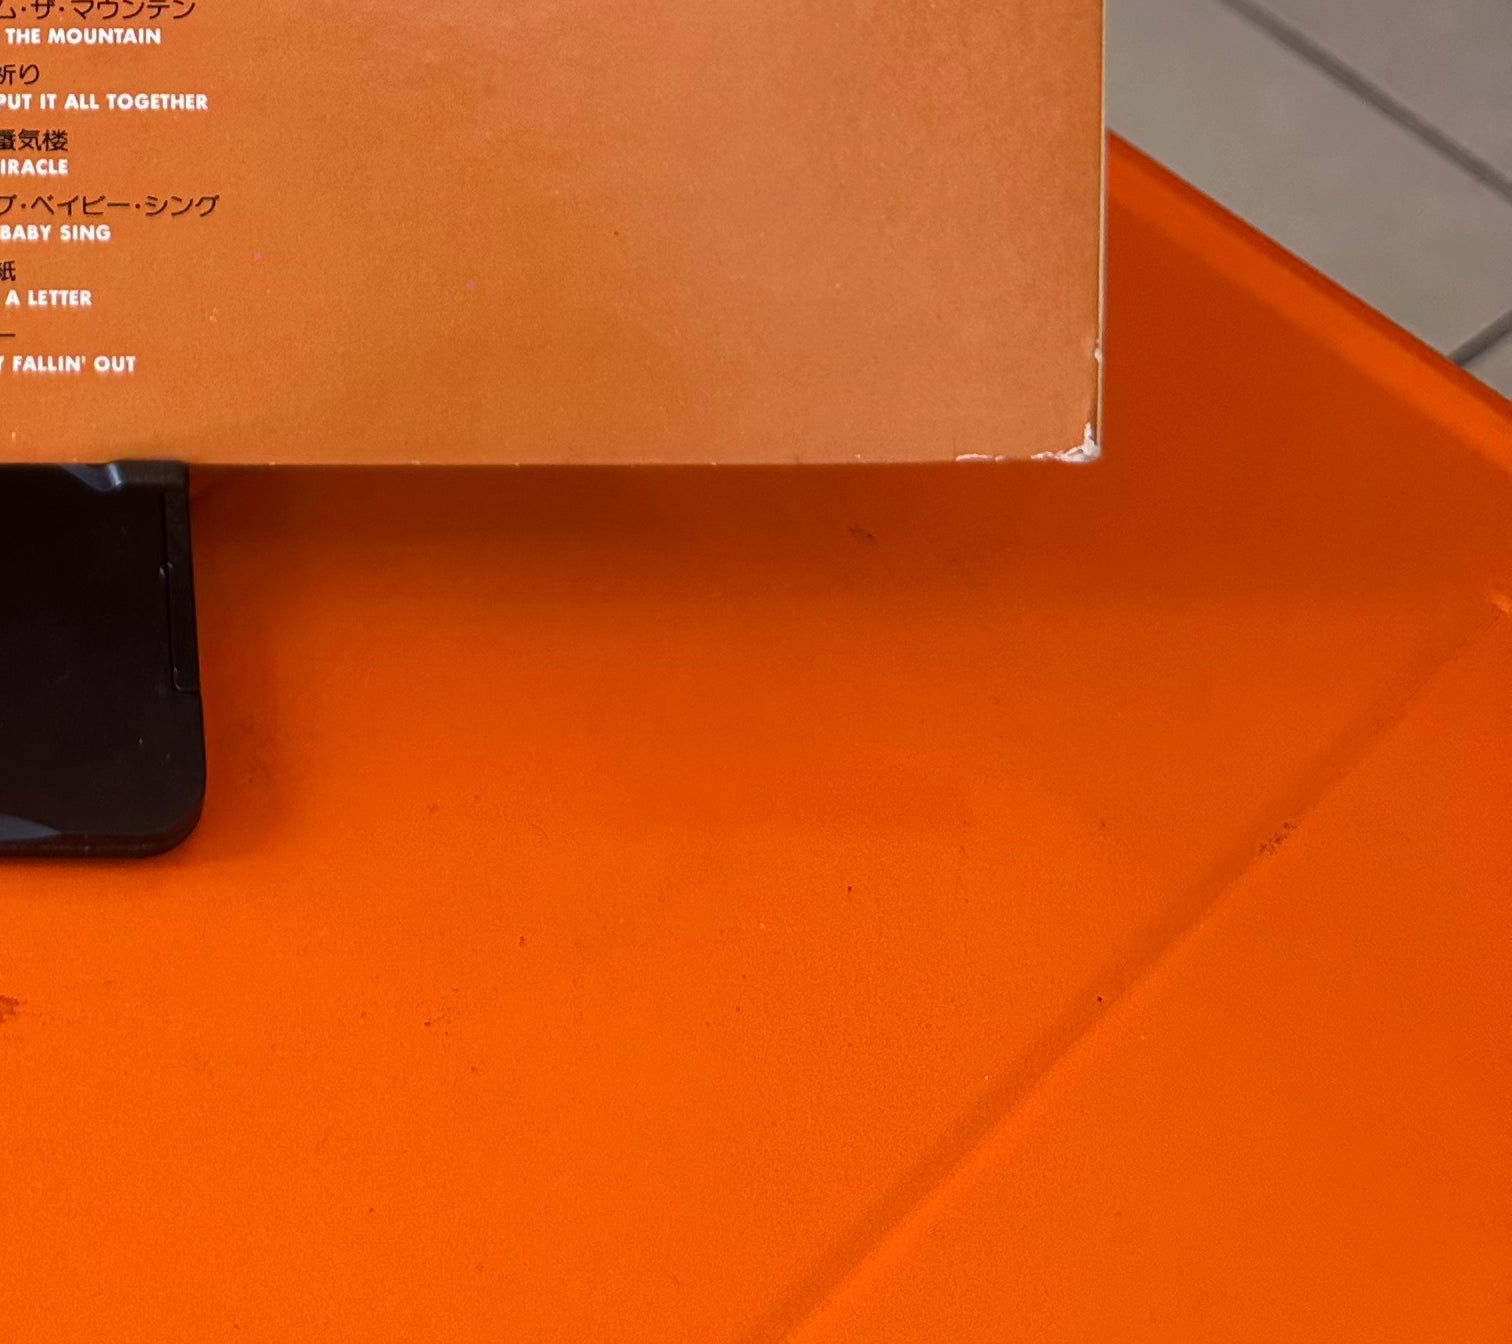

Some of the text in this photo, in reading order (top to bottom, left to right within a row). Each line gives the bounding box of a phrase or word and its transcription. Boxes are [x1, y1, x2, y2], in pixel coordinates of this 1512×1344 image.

[6, 28, 40, 44] THE
[48, 28, 160, 44] MOUNTAIN
[40, 94, 56, 109] IT
[65, 94, 99, 109] ALL
[107, 94, 207, 110] TOGETHER
[0, 225, 51, 241] BABY
[61, 225, 110, 241] SING
[6, 290, 20, 305] A
[28, 290, 91, 306] LETTER
[13, 356, 85, 372] FALLIN'
[94, 356, 135, 373] OUT
